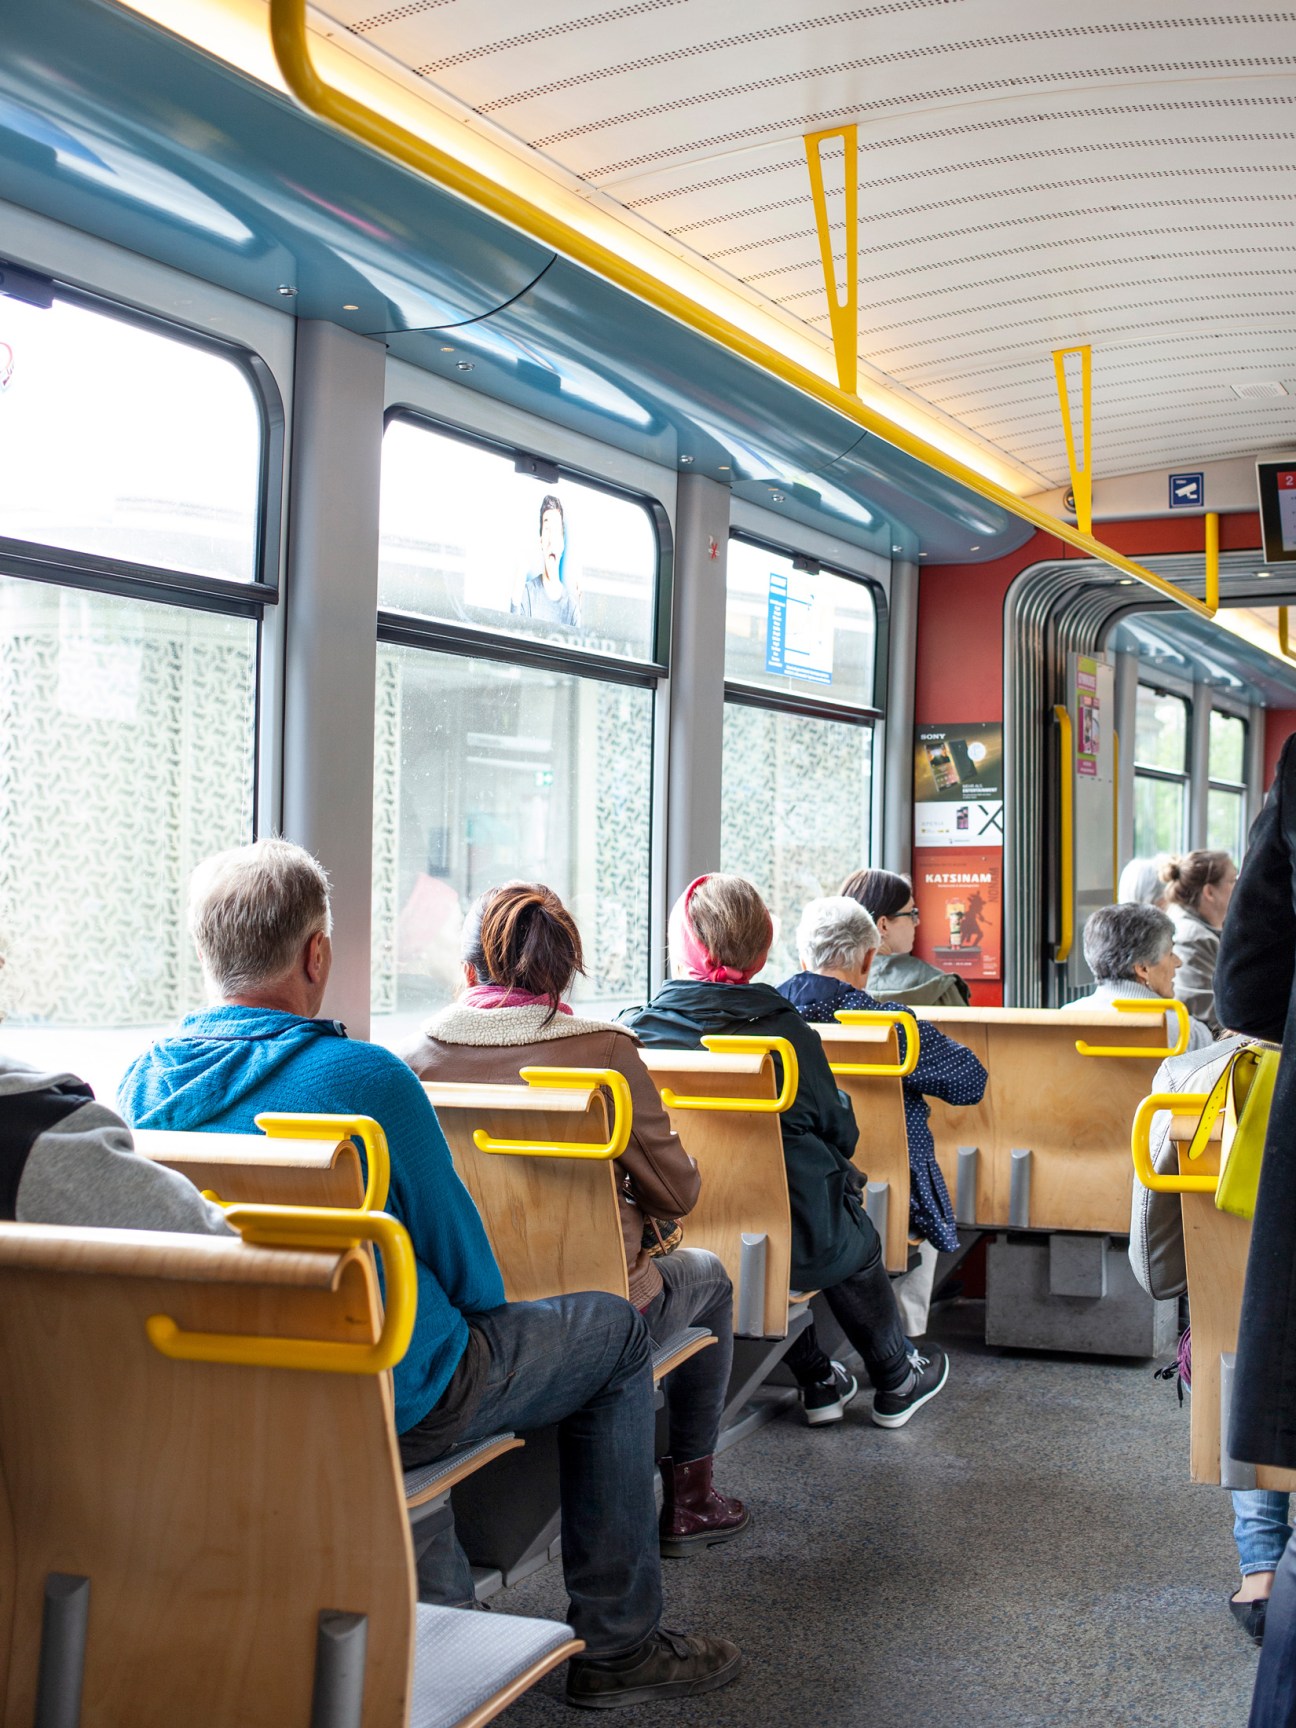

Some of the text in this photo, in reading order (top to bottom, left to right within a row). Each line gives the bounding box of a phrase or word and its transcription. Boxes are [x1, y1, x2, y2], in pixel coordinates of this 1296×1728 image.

[1285, 475, 1294, 486] 2
[920, 733, 946, 741] SONY
[925, 873, 992, 883] KATSINAM
